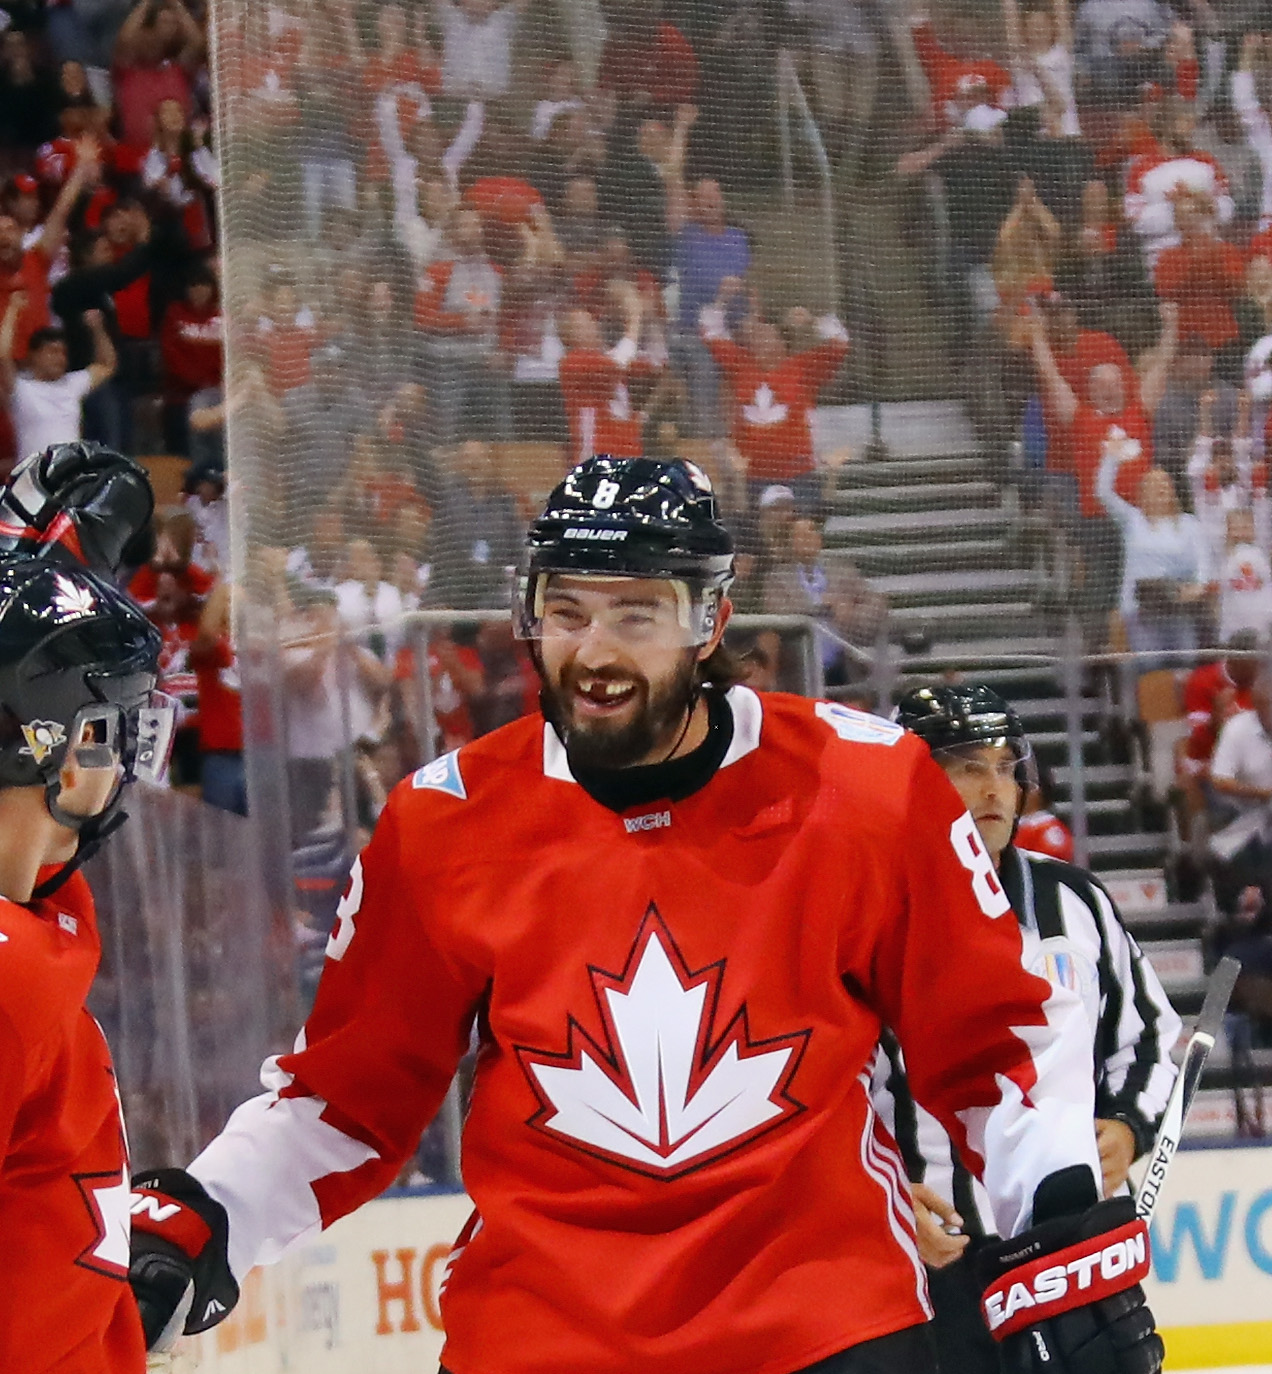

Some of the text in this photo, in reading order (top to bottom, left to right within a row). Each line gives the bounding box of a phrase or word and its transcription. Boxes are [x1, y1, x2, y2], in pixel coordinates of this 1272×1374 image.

[592, 478, 621, 510] 8
[563, 527, 629, 541] BAUER
[624, 811, 671, 833] WCH
[950, 809, 1011, 919] 8
[1136, 1136, 1176, 1221] EASTON
[985, 1232, 1145, 1331] EASTON
